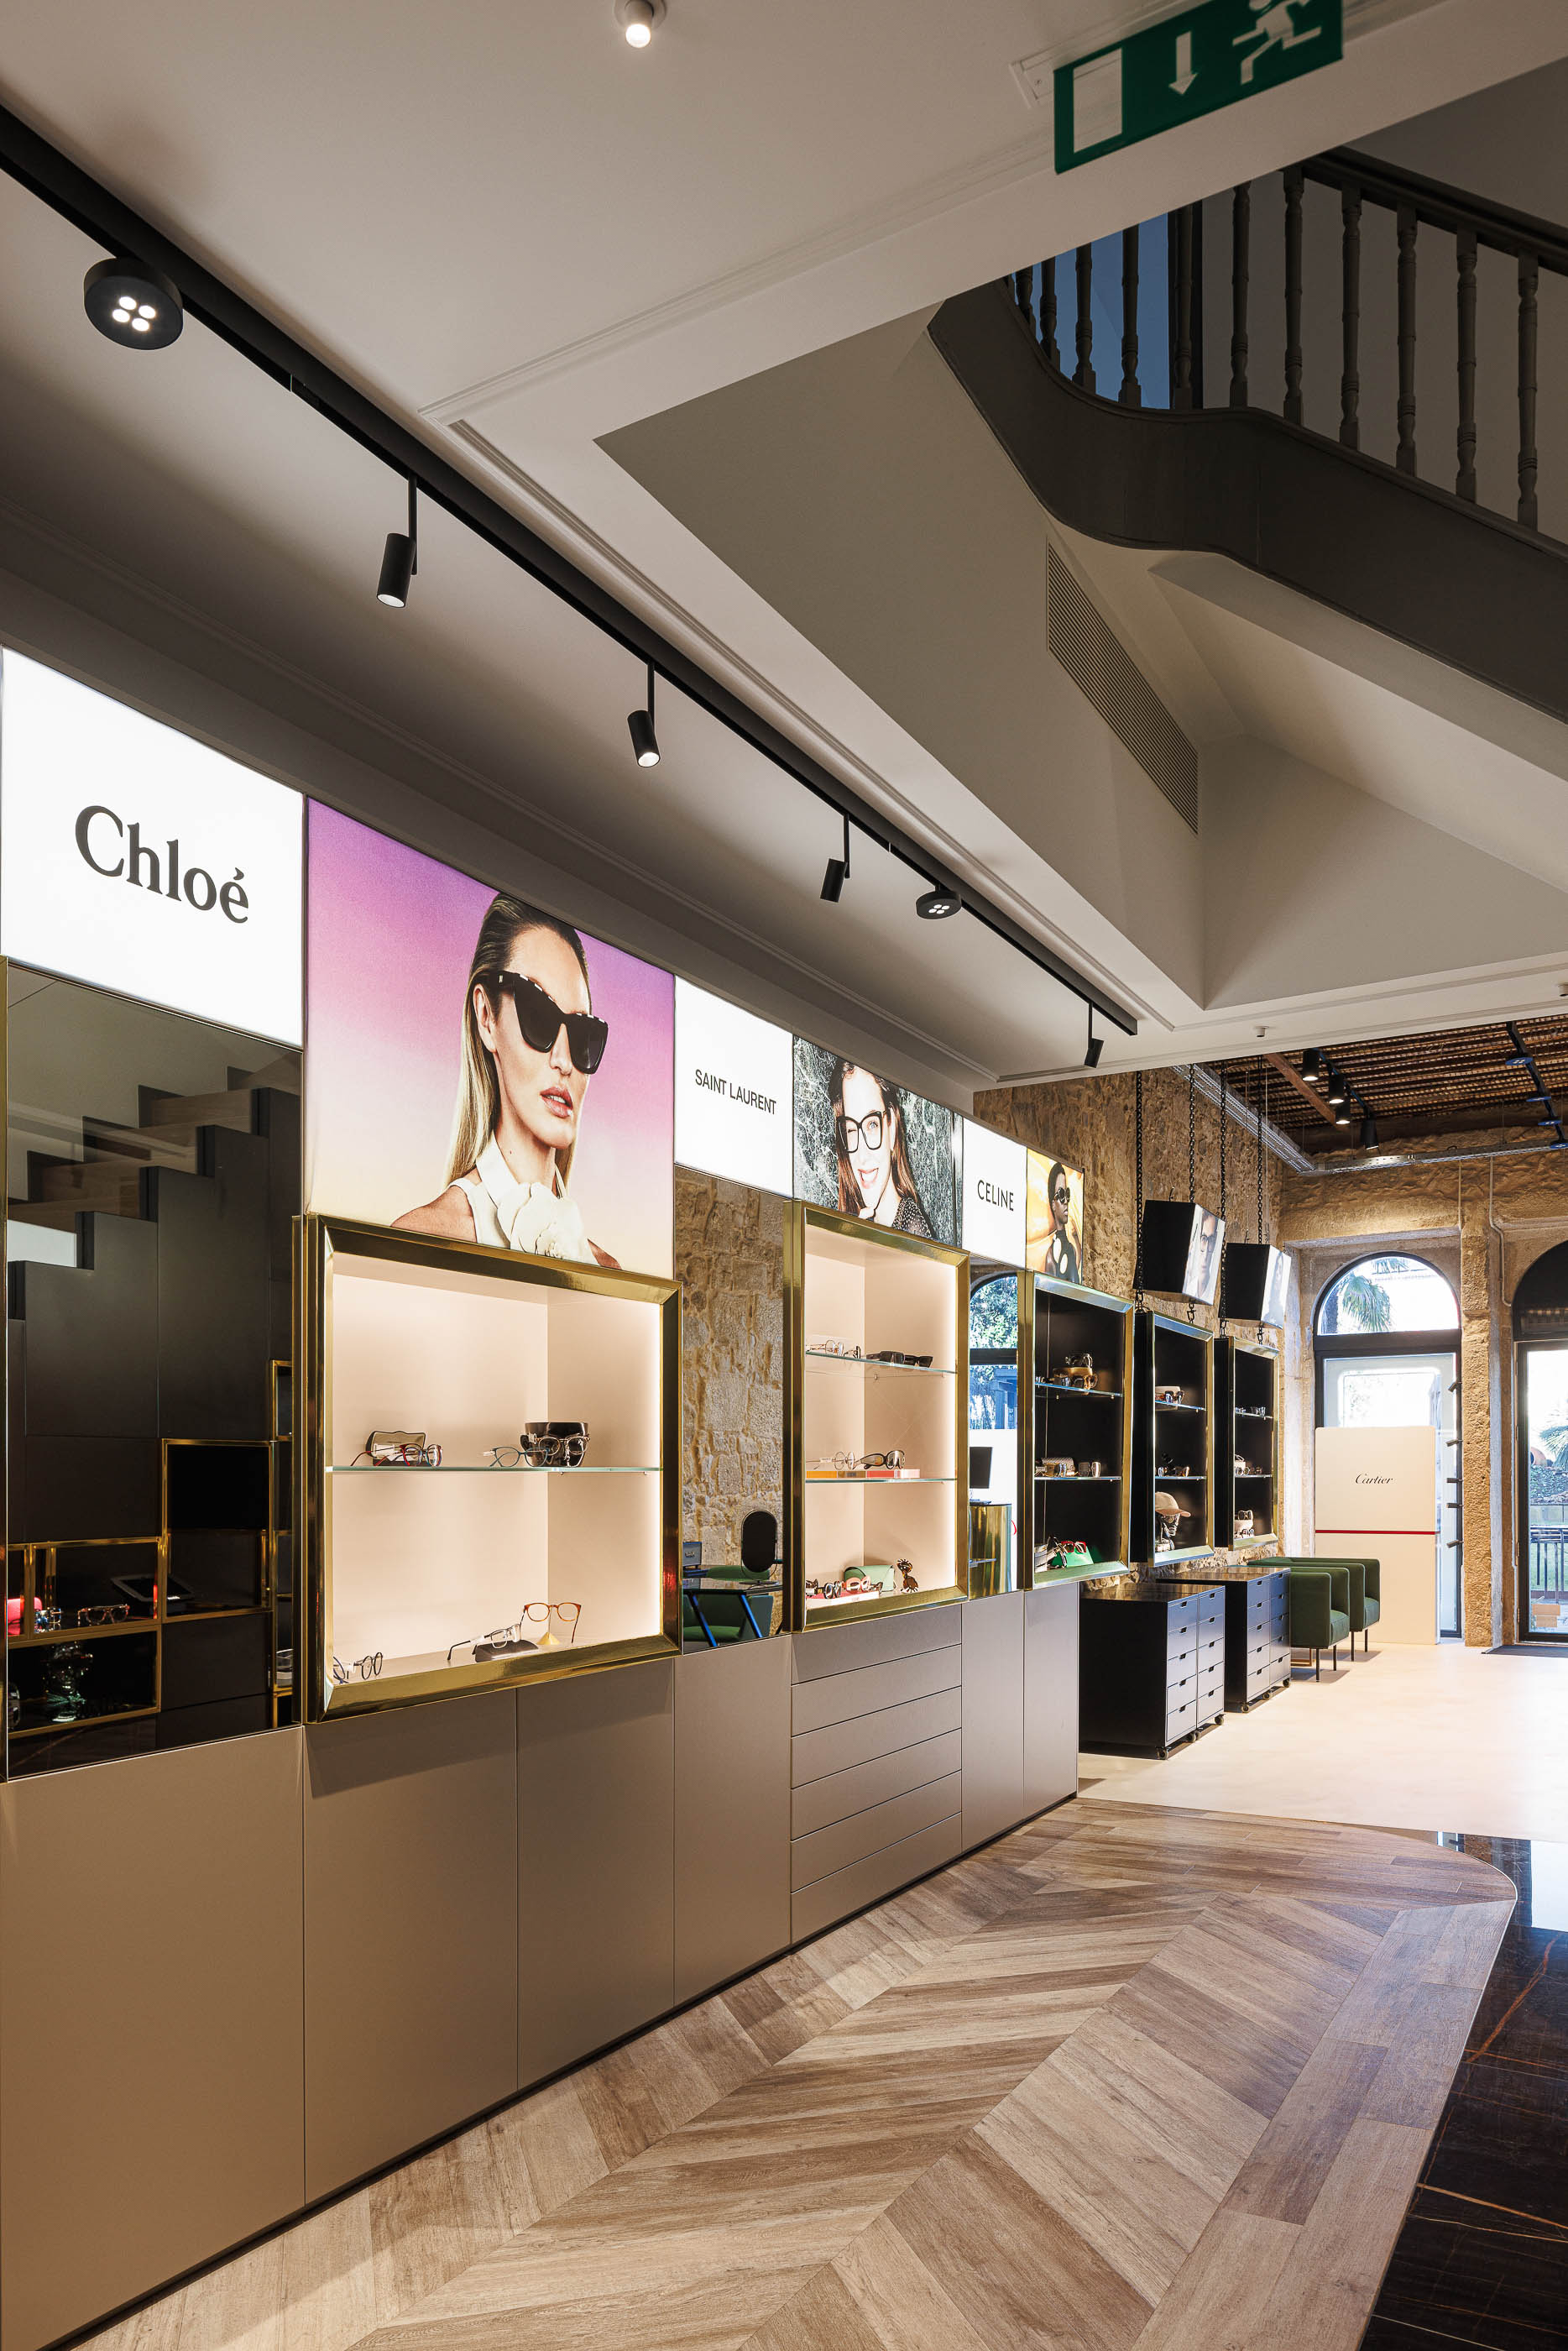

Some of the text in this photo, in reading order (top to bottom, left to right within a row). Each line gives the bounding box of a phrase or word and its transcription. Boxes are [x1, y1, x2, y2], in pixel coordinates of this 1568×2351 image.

[75, 804, 249, 924] Chloé
[695, 1069, 776, 1115] SAINT LAURENT
[977, 1179, 1014, 1212] CELINE
[1355, 1473, 1394, 1484] Cartier
